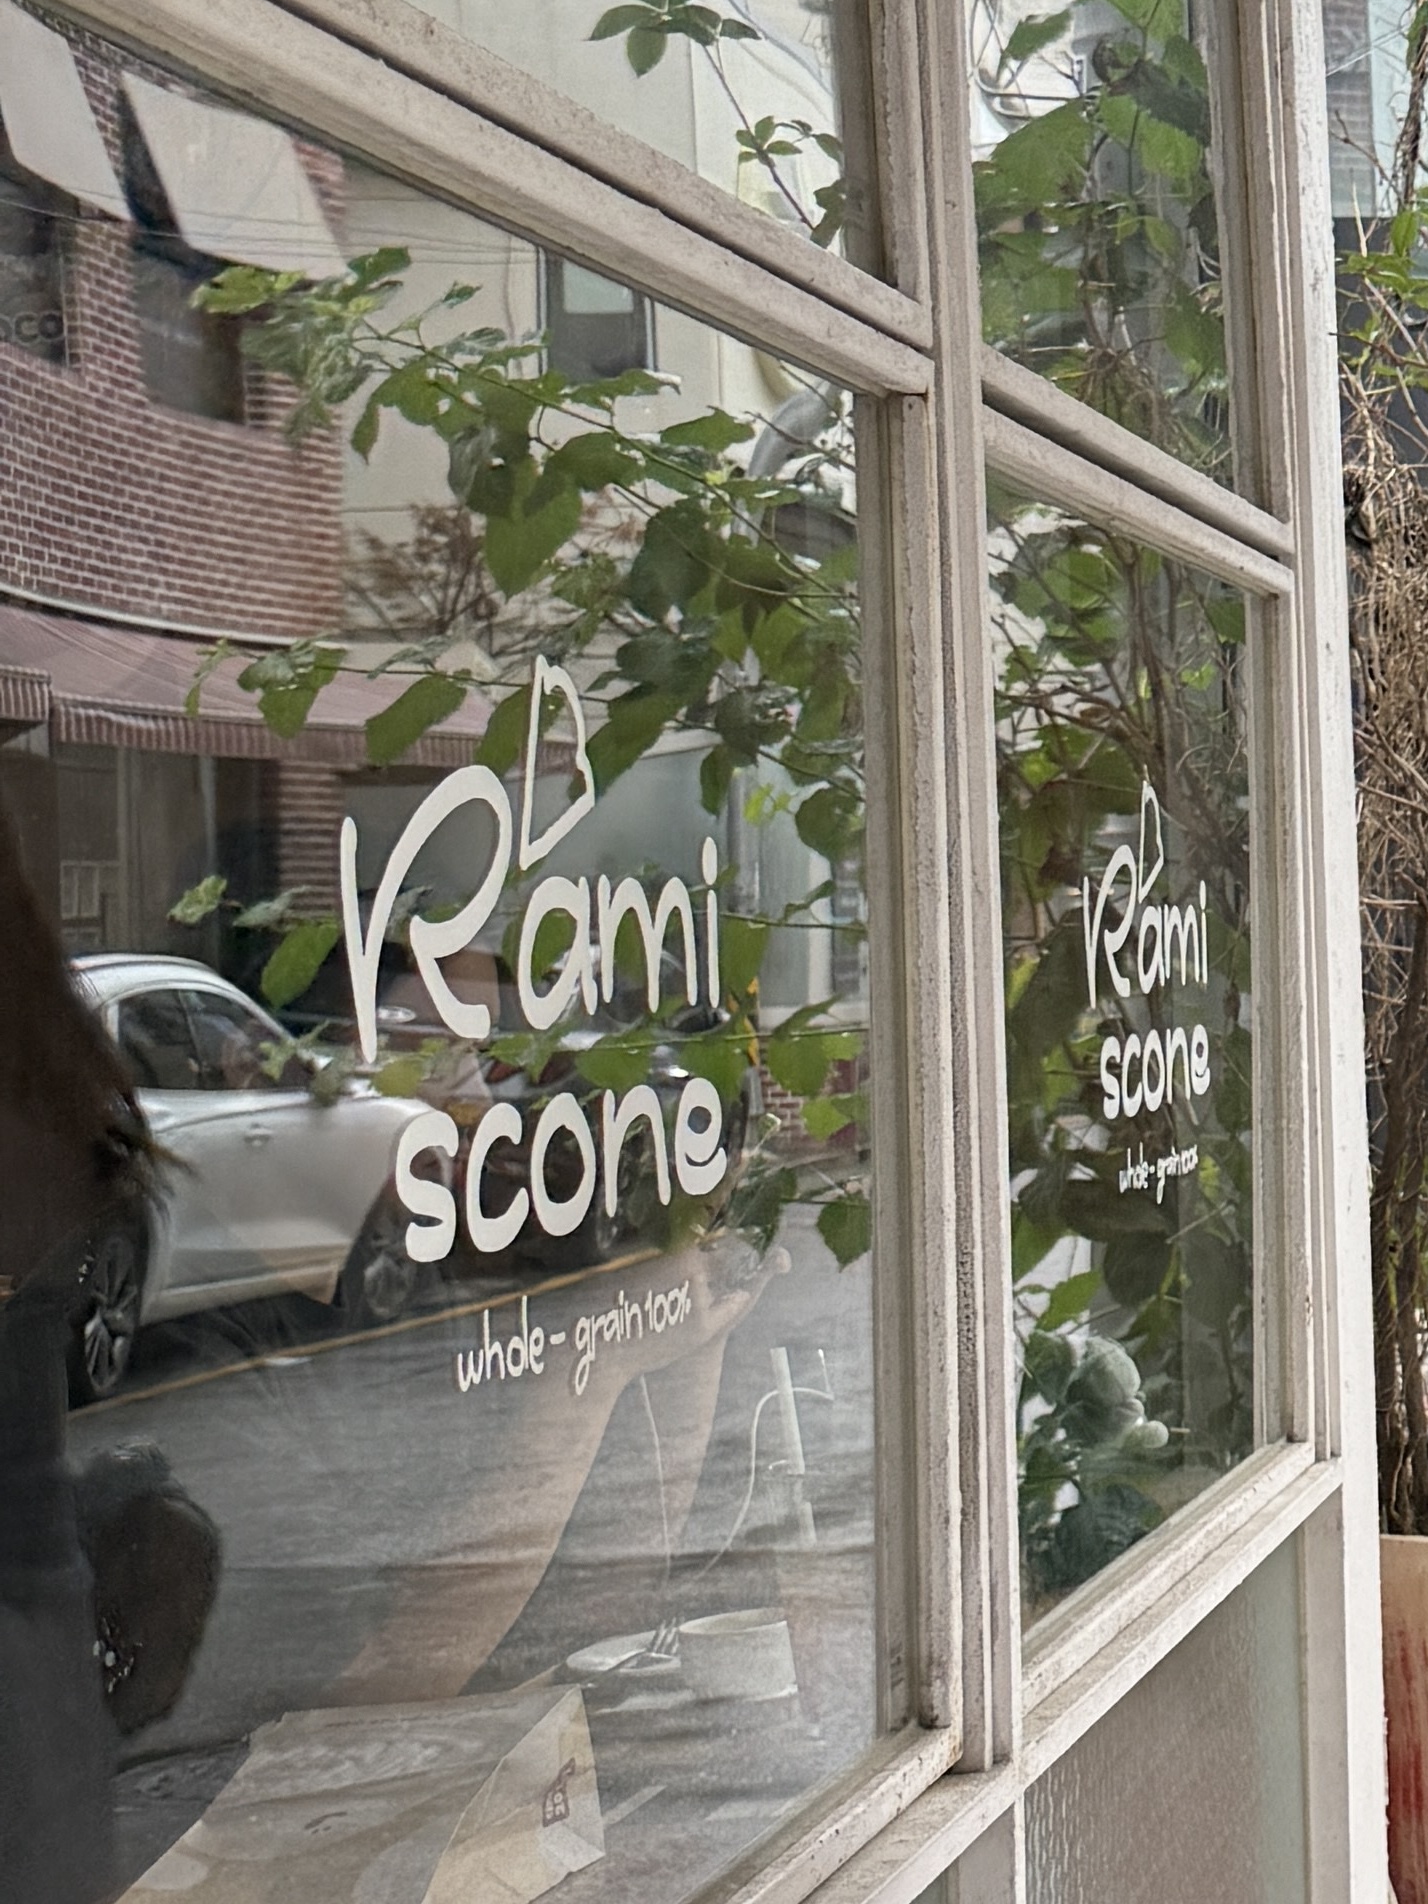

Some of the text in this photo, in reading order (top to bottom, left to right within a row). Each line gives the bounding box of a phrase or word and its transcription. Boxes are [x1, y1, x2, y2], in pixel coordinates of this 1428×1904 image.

[340, 764, 720, 1063] Rami
[1083, 844, 1208, 1009] Rami
[1100, 1024, 1211, 1120] scone
[396, 1077, 728, 1263] scone
